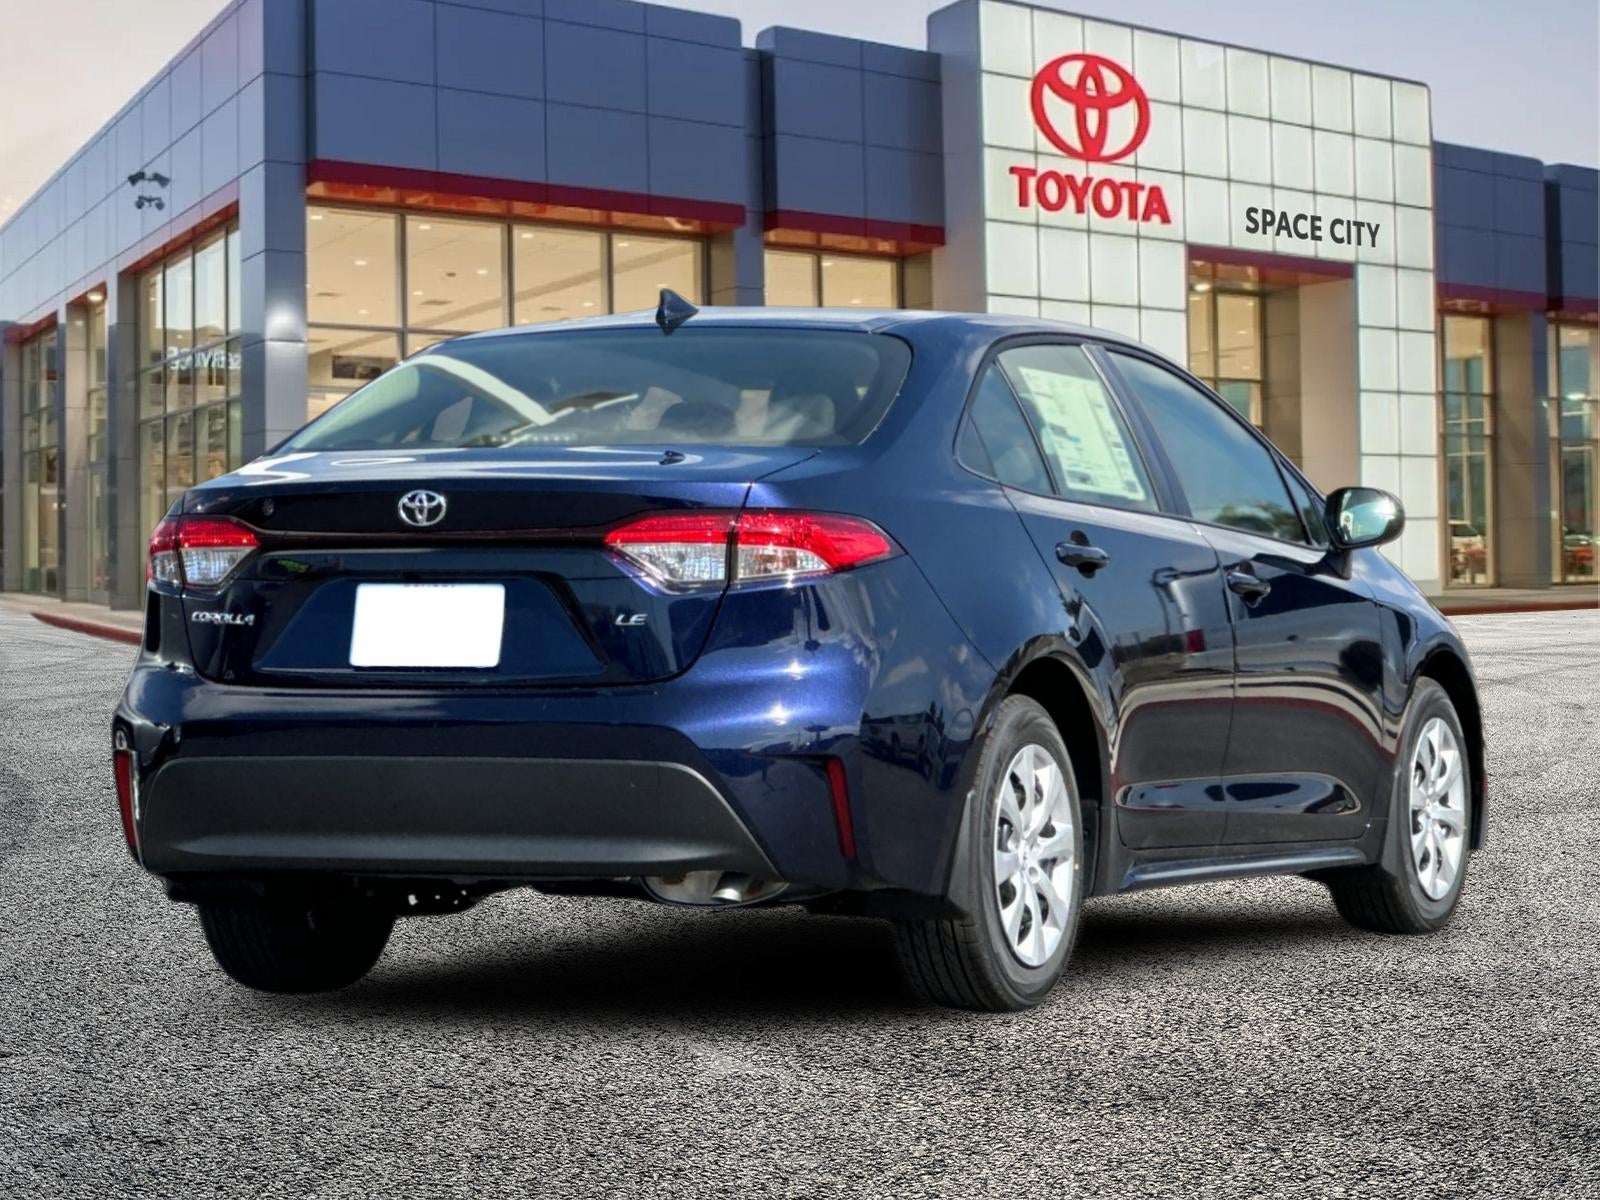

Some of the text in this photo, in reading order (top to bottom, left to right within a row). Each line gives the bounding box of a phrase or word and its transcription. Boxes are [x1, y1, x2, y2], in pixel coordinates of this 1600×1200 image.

[1009, 166, 1171, 225] TOYOTA
[1245, 206, 1381, 248] SPACE CITY
[191, 610, 255, 626] COROLLA
[615, 613, 648, 626] LE
